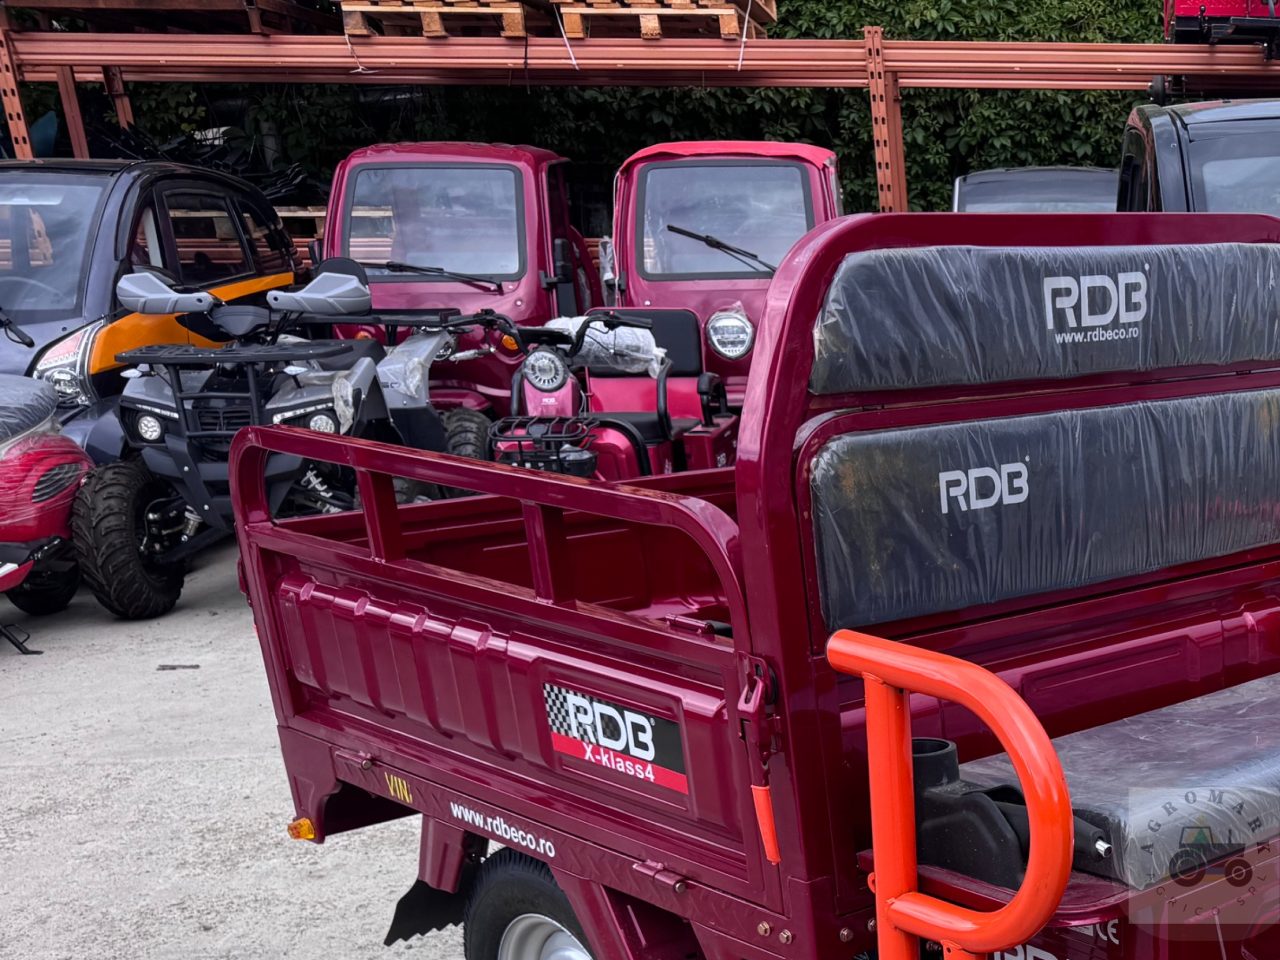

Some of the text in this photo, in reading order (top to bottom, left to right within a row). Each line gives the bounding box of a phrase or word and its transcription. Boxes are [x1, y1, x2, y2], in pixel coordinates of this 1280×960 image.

[1043, 271, 1148, 330] RDB
[1055, 327, 1139, 344] www.rdbeco.ro
[939, 462, 1029, 514] RDB
[566, 693, 655, 761] RDB
[583, 742, 656, 782] X-klass4
[450, 801, 556, 858] www.rdbeco.ro
